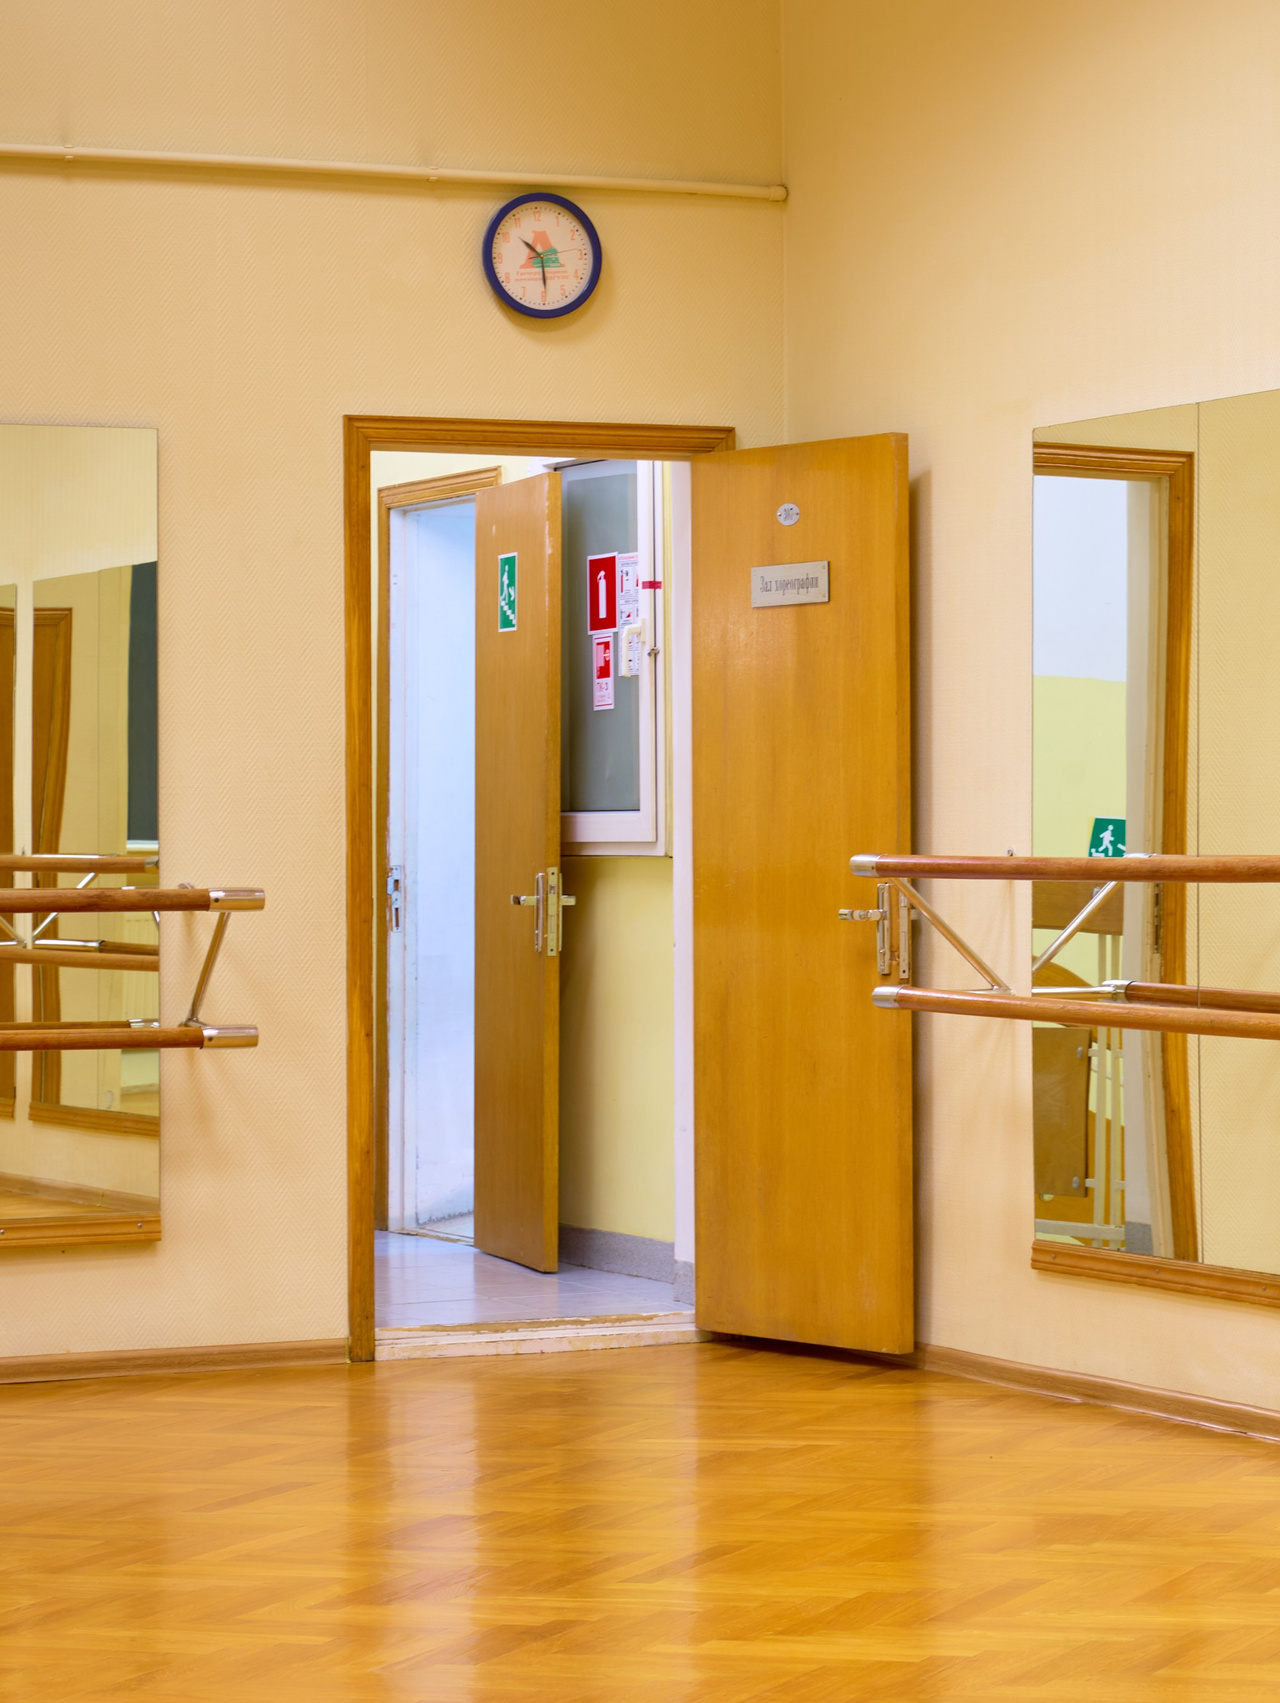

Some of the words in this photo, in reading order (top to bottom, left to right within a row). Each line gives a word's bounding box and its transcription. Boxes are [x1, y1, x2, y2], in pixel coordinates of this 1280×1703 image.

[533, 210, 542, 222] 12
[555, 216, 560, 226] 1
[514, 217, 522, 229] 11
[502, 232, 511, 244] 10
[570, 229, 576, 241] 2
[497, 252, 503, 264] 9
[577, 249, 583, 261] 3
[505, 272, 511, 284] 8
[573, 268, 579, 281] 4
[521, 286, 526, 298] 7
[560, 284, 567, 296] 5
[759, 575, 772, 593] Зал
[774, 572, 819, 596] хореографии
